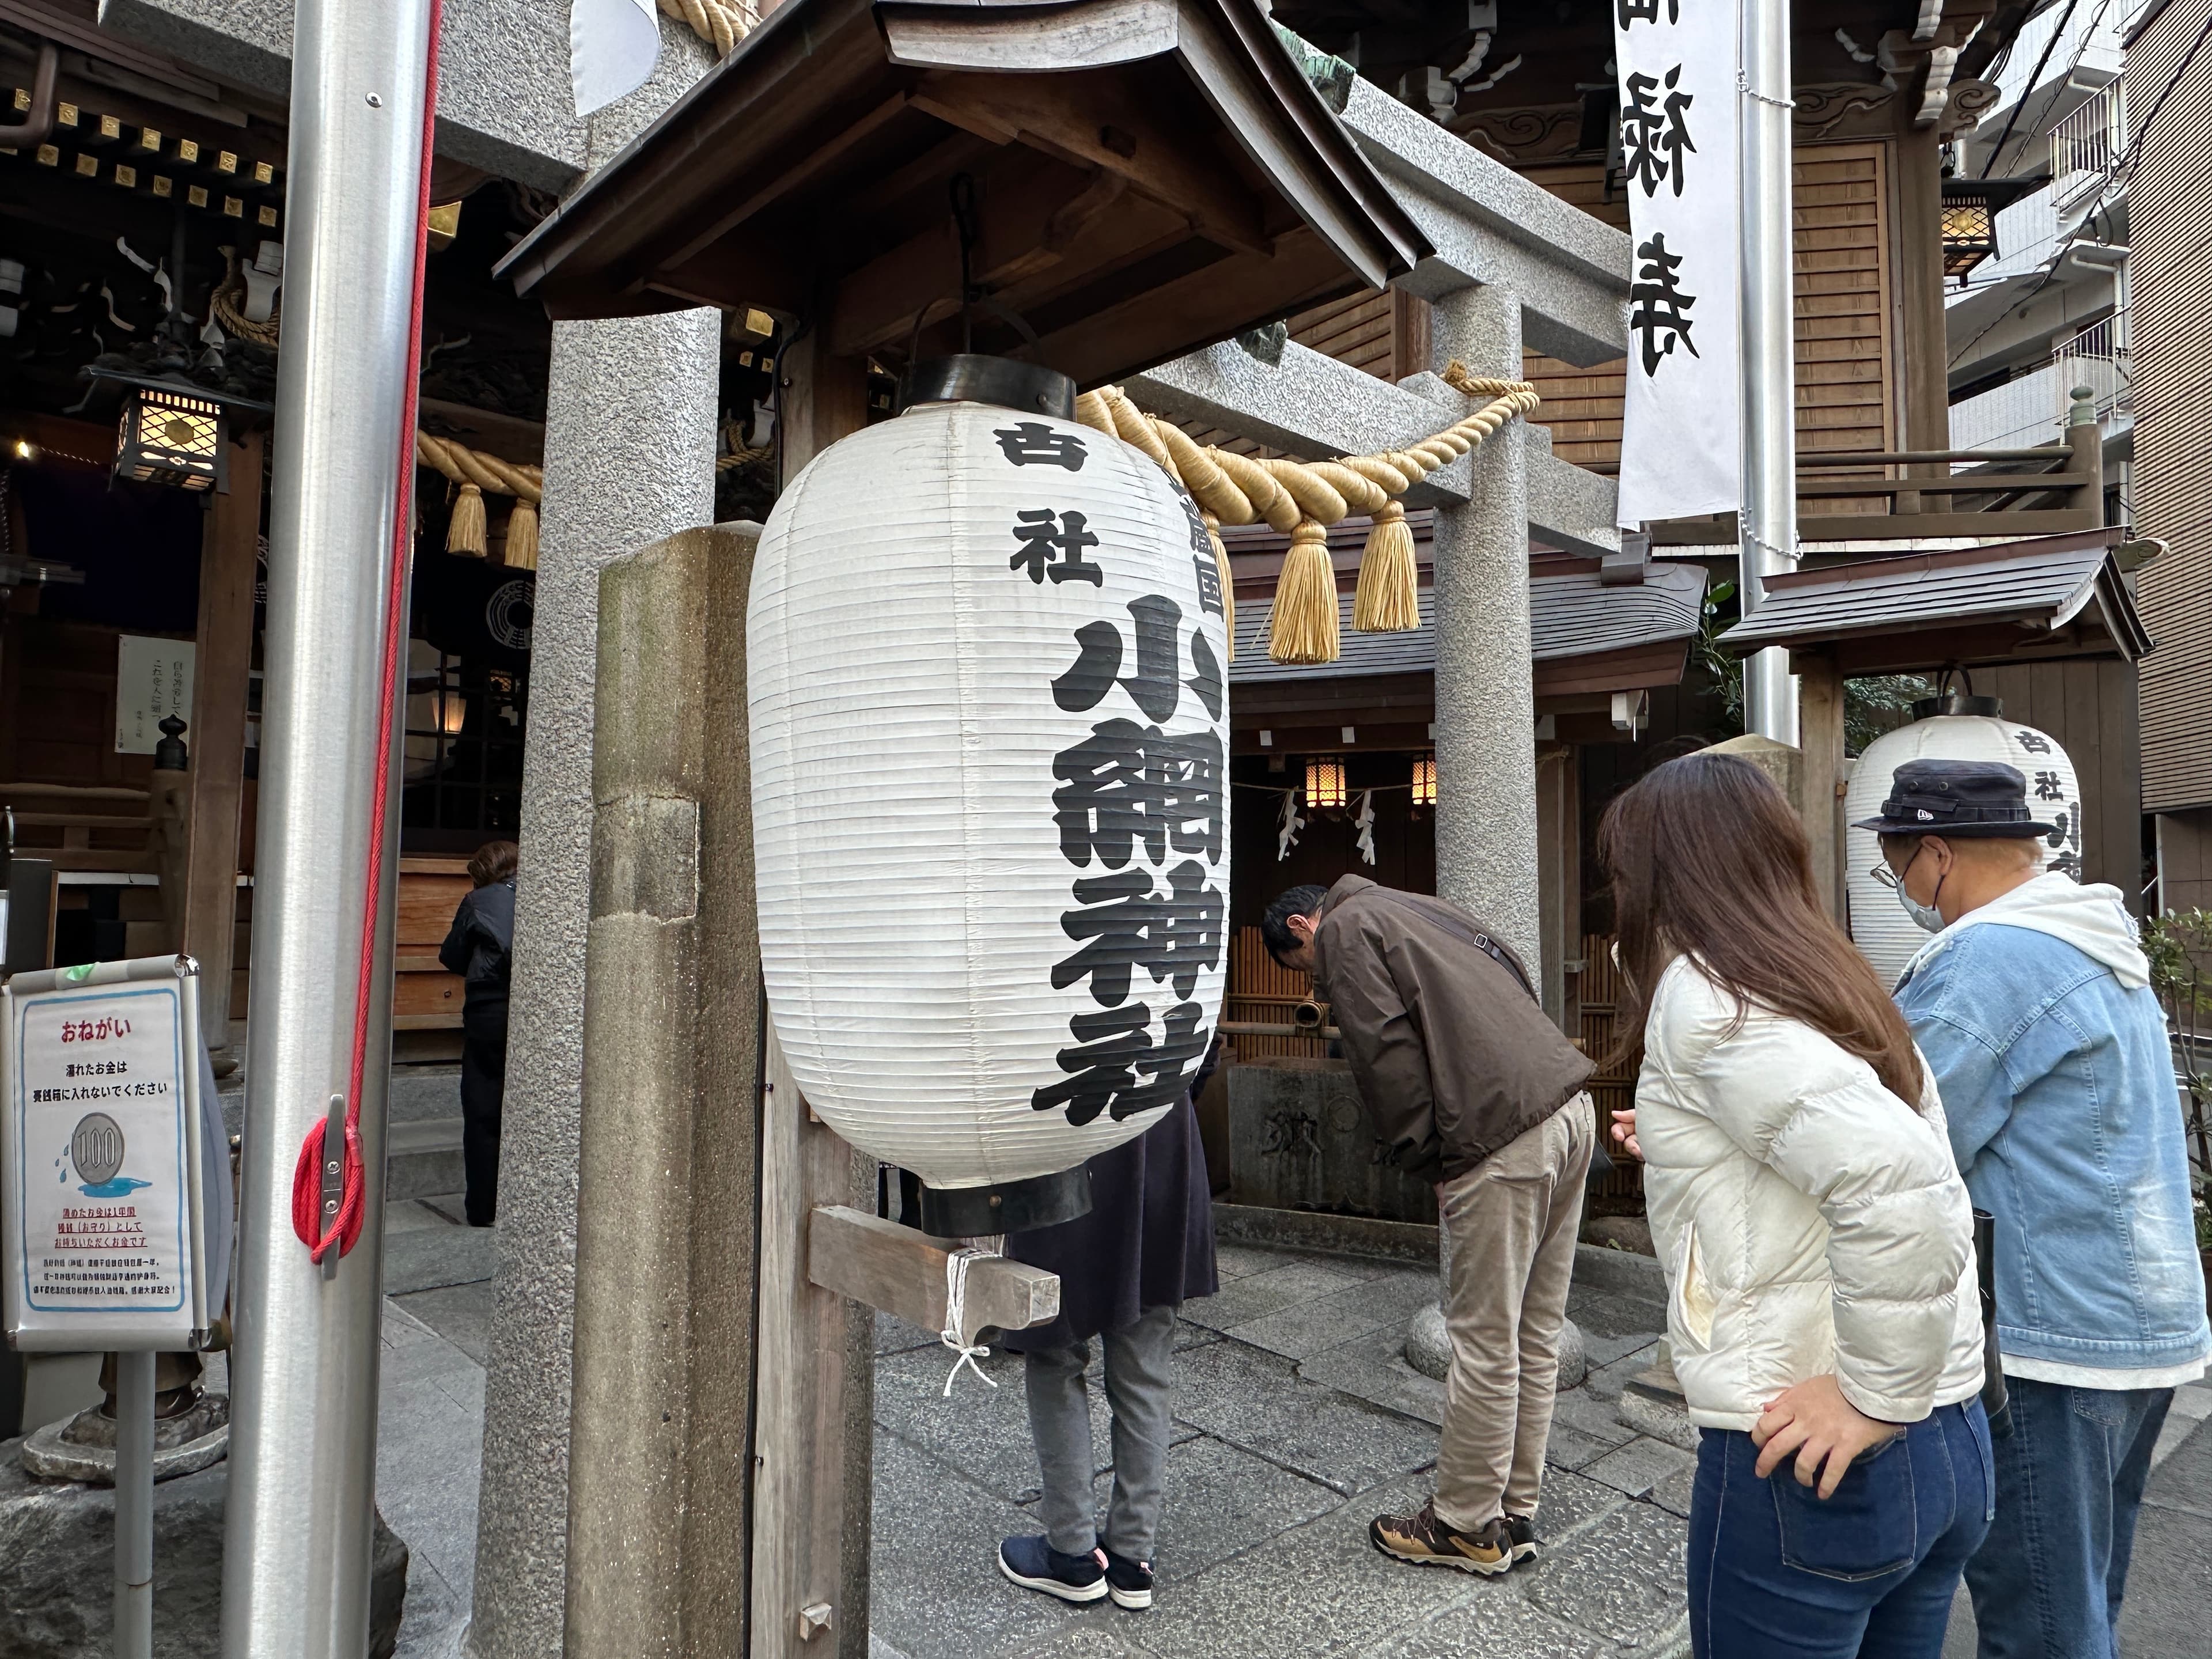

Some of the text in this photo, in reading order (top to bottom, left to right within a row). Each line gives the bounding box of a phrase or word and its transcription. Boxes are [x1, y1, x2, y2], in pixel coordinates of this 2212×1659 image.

[1031, 594, 1225, 1127] 小網神社
[61, 1017, 131, 1043] おねがい
[78, 1127, 115, 1168] 100
